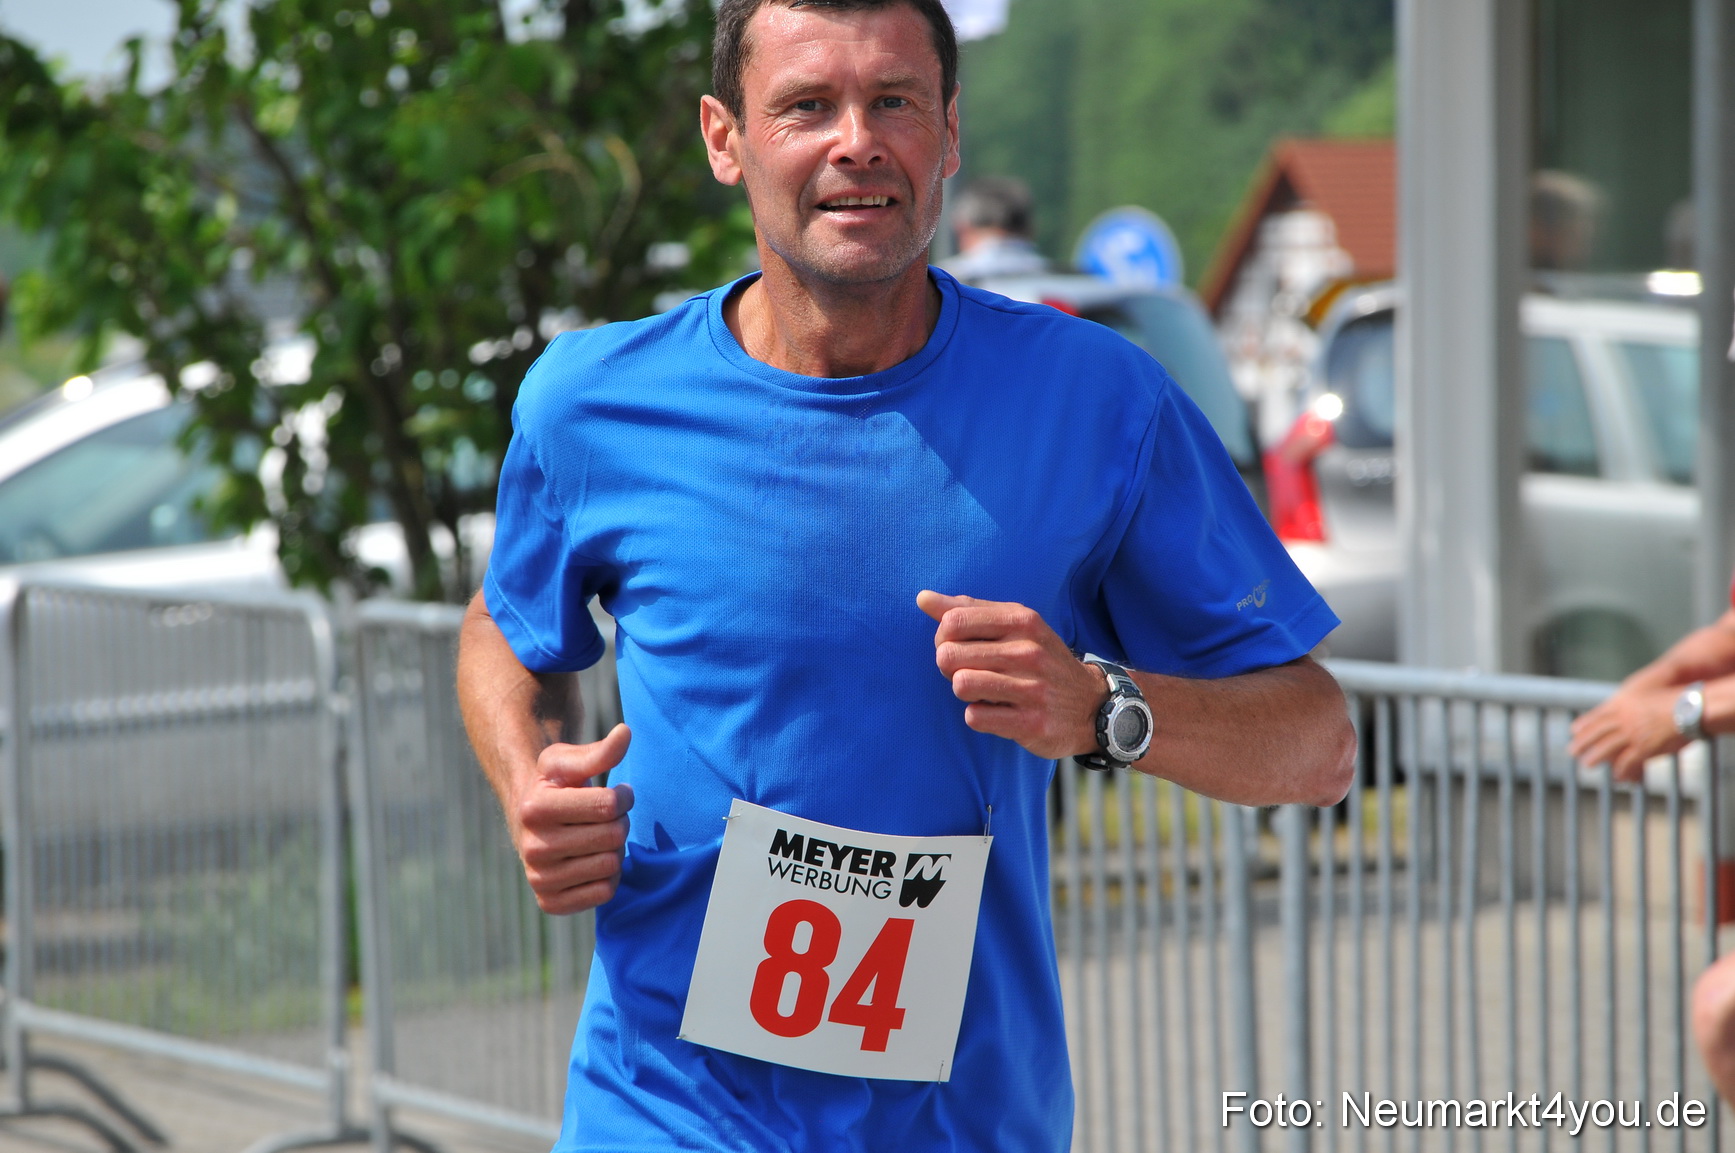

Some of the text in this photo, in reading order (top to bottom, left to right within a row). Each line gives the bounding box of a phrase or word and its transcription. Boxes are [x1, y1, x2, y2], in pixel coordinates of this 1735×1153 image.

[767, 857, 892, 900] WERBUNG
[768, 828, 897, 879] MEYER
[749, 899, 915, 1053] 84
